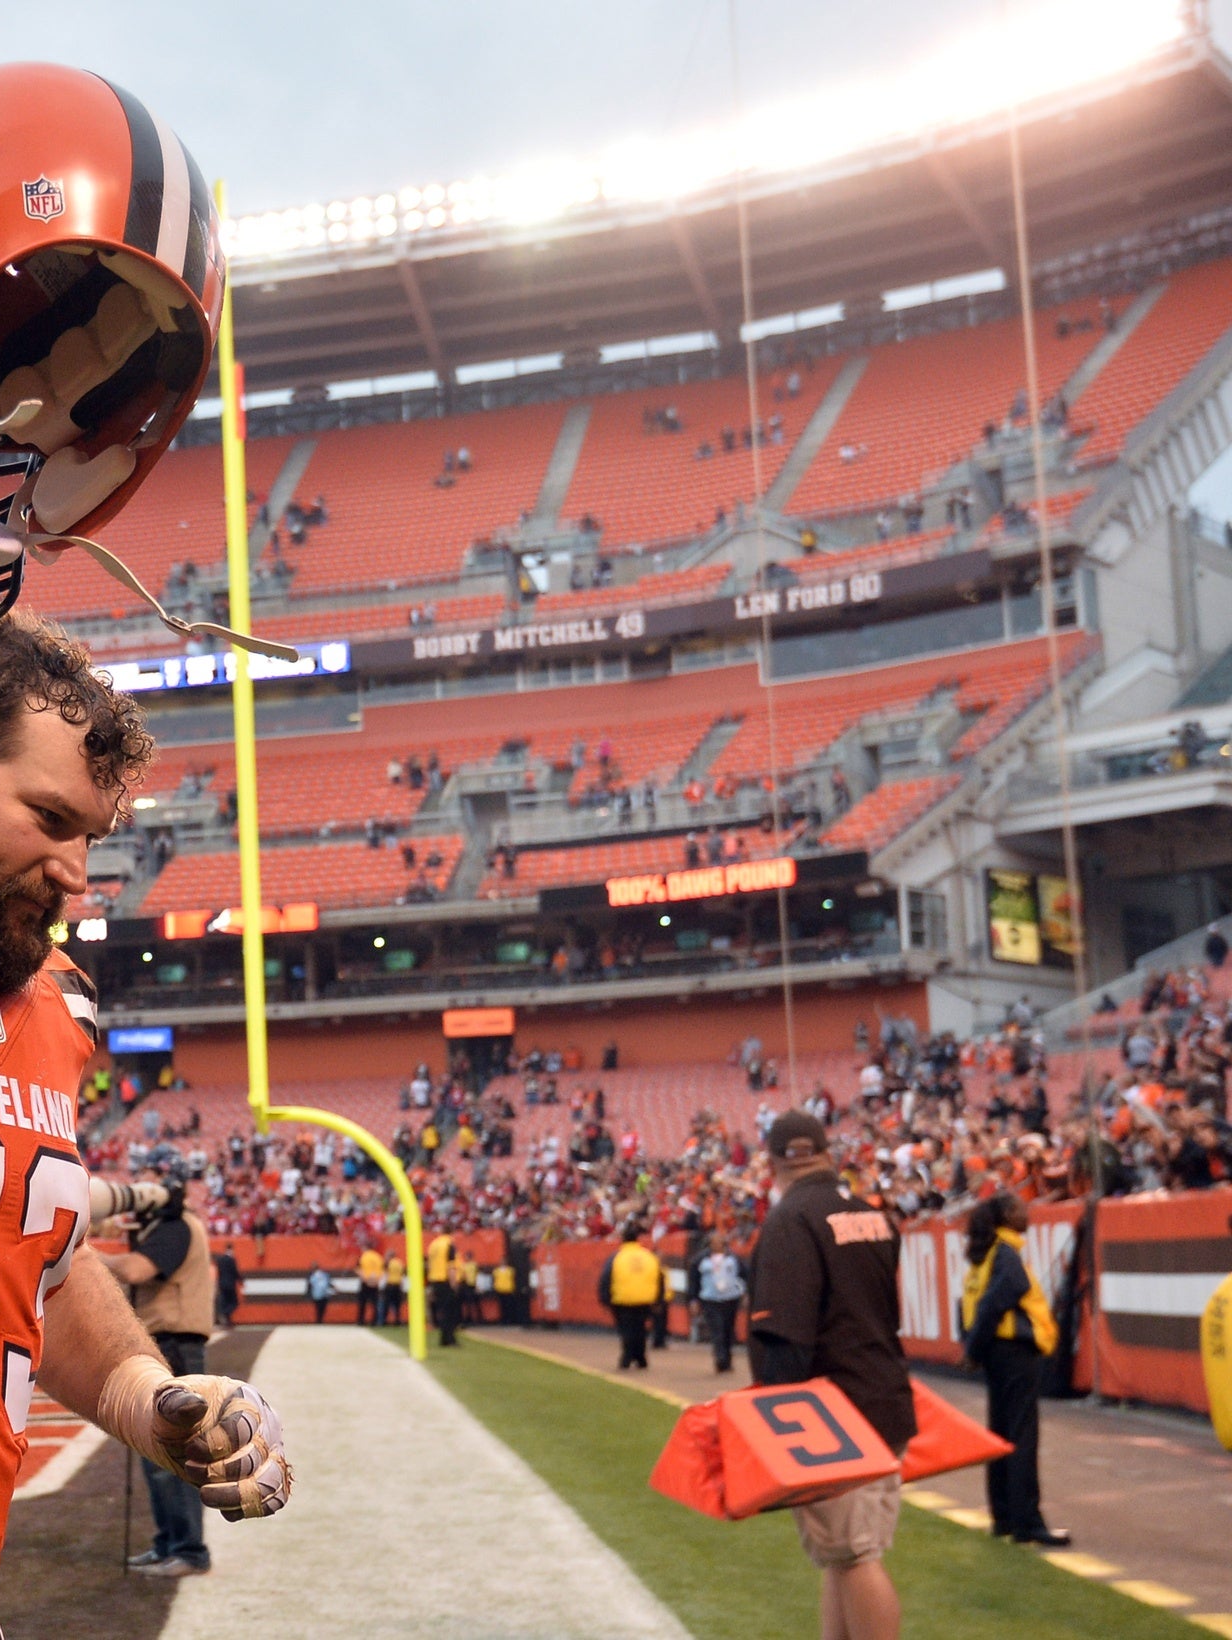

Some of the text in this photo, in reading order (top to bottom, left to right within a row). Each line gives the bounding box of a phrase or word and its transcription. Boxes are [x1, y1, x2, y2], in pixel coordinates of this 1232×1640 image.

[30, 195, 60, 215] NFL
[413, 610, 646, 660] BOBBY MITCHELL 49
